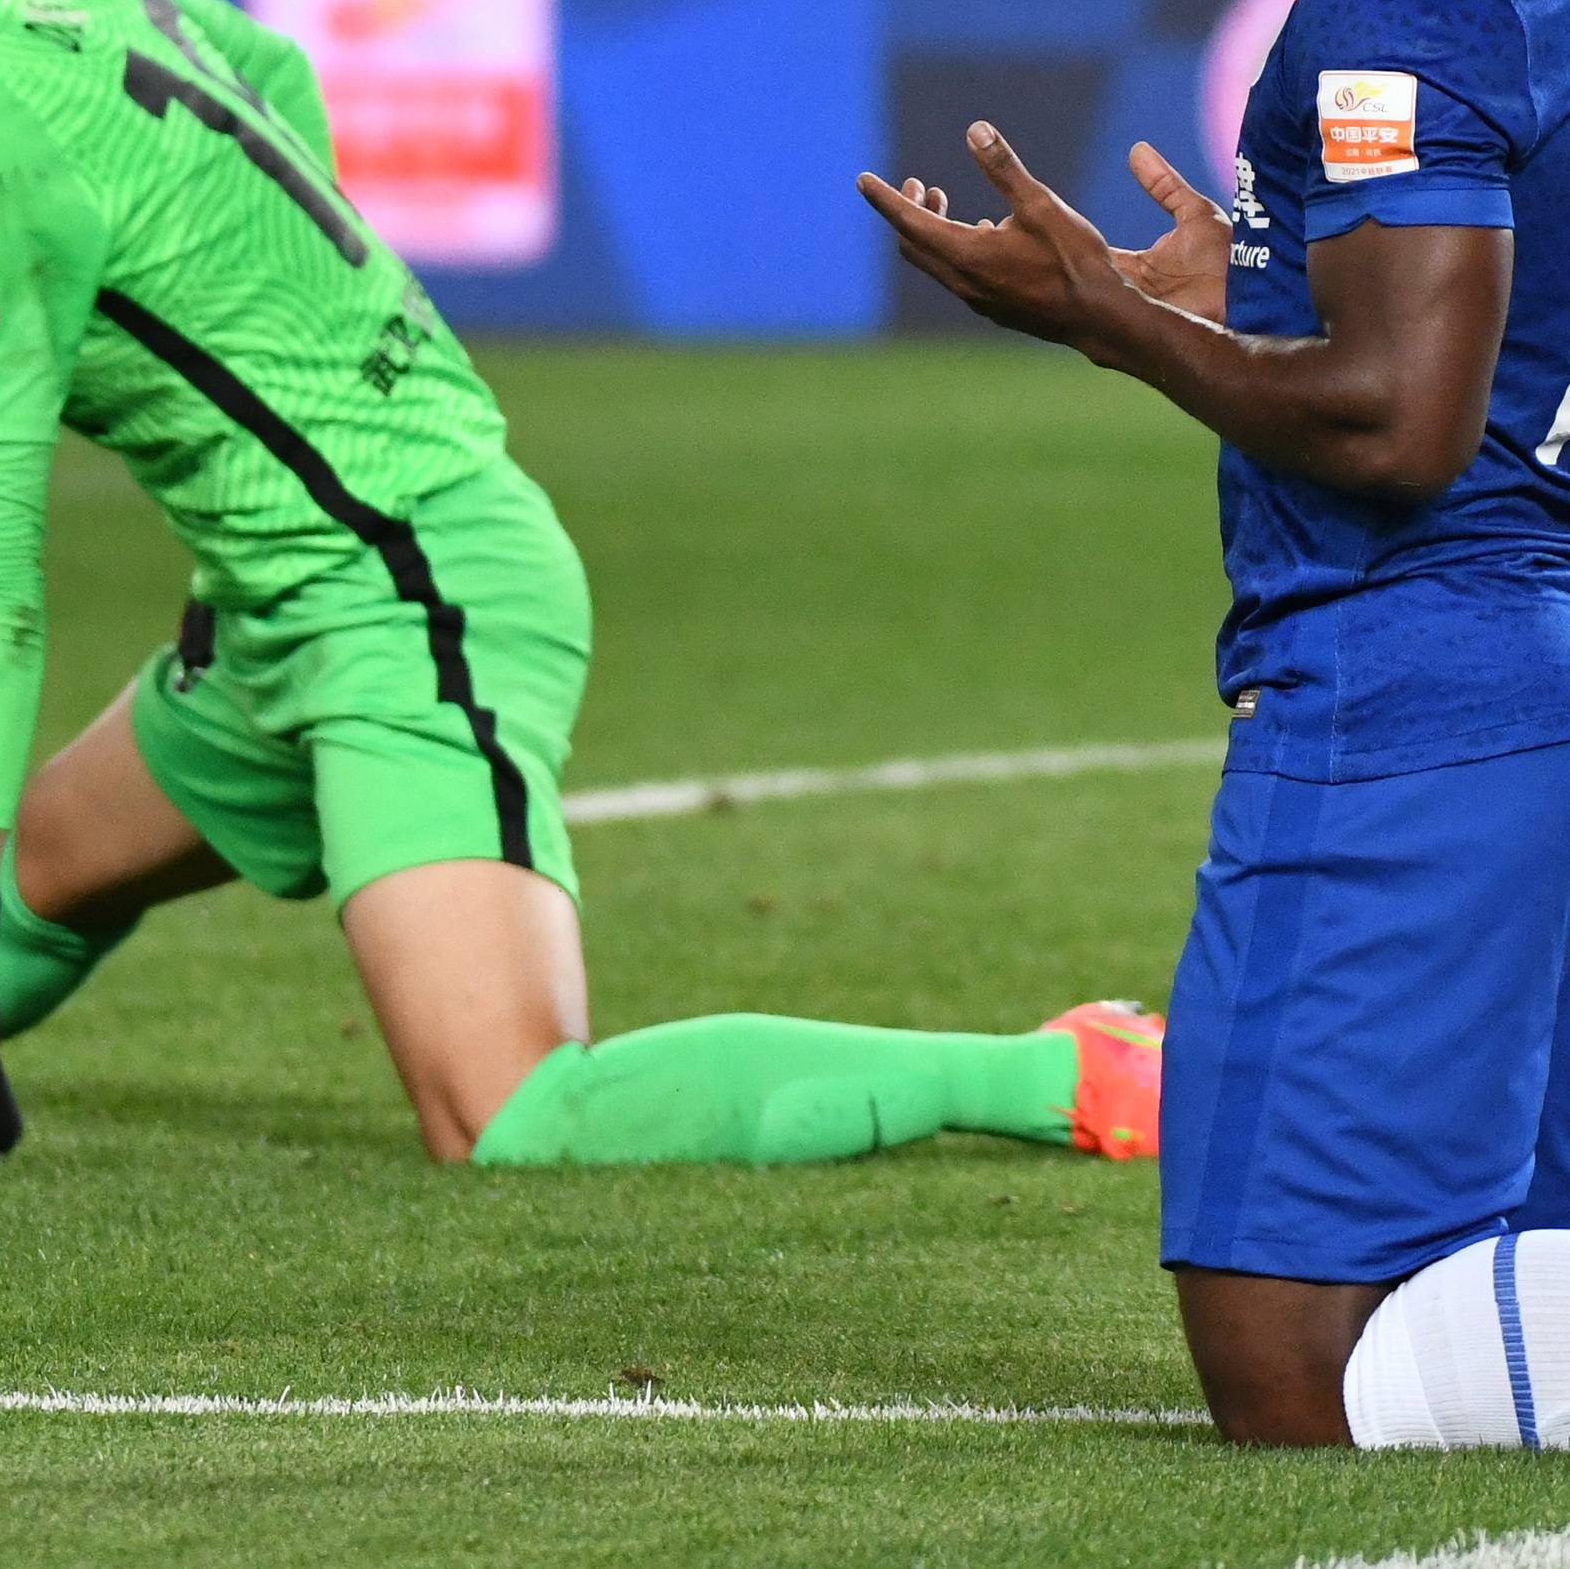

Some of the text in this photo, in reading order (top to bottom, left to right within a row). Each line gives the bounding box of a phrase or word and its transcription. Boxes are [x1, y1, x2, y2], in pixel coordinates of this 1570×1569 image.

[1362, 102, 1389, 113] CSL
[1330, 125, 1399, 144] 中国平安
